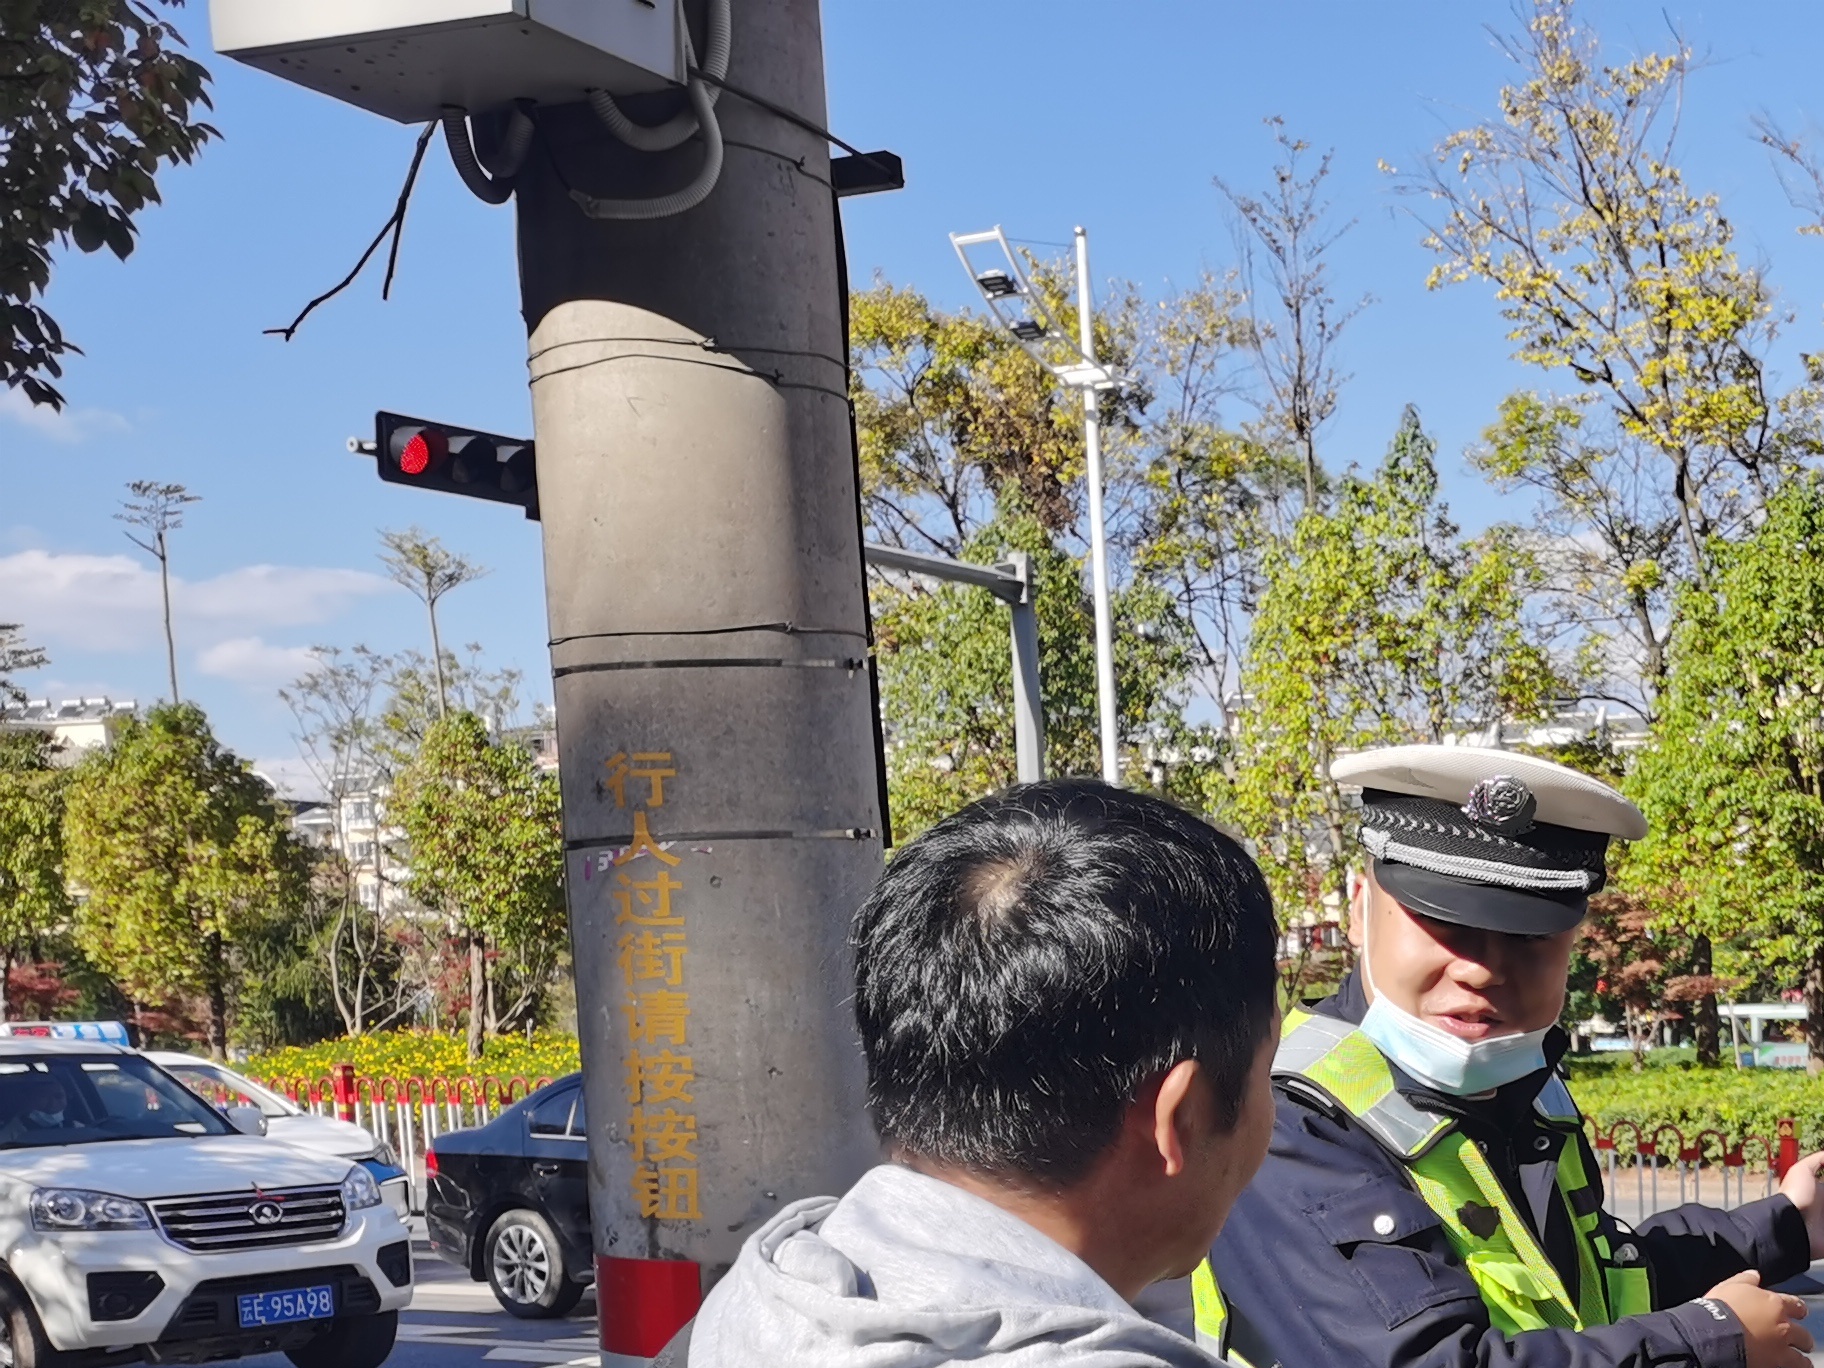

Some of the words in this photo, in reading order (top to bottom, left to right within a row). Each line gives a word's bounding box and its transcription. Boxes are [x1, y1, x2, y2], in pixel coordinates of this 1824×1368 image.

[605, 751, 703, 1221] 行人过街请按按钮
